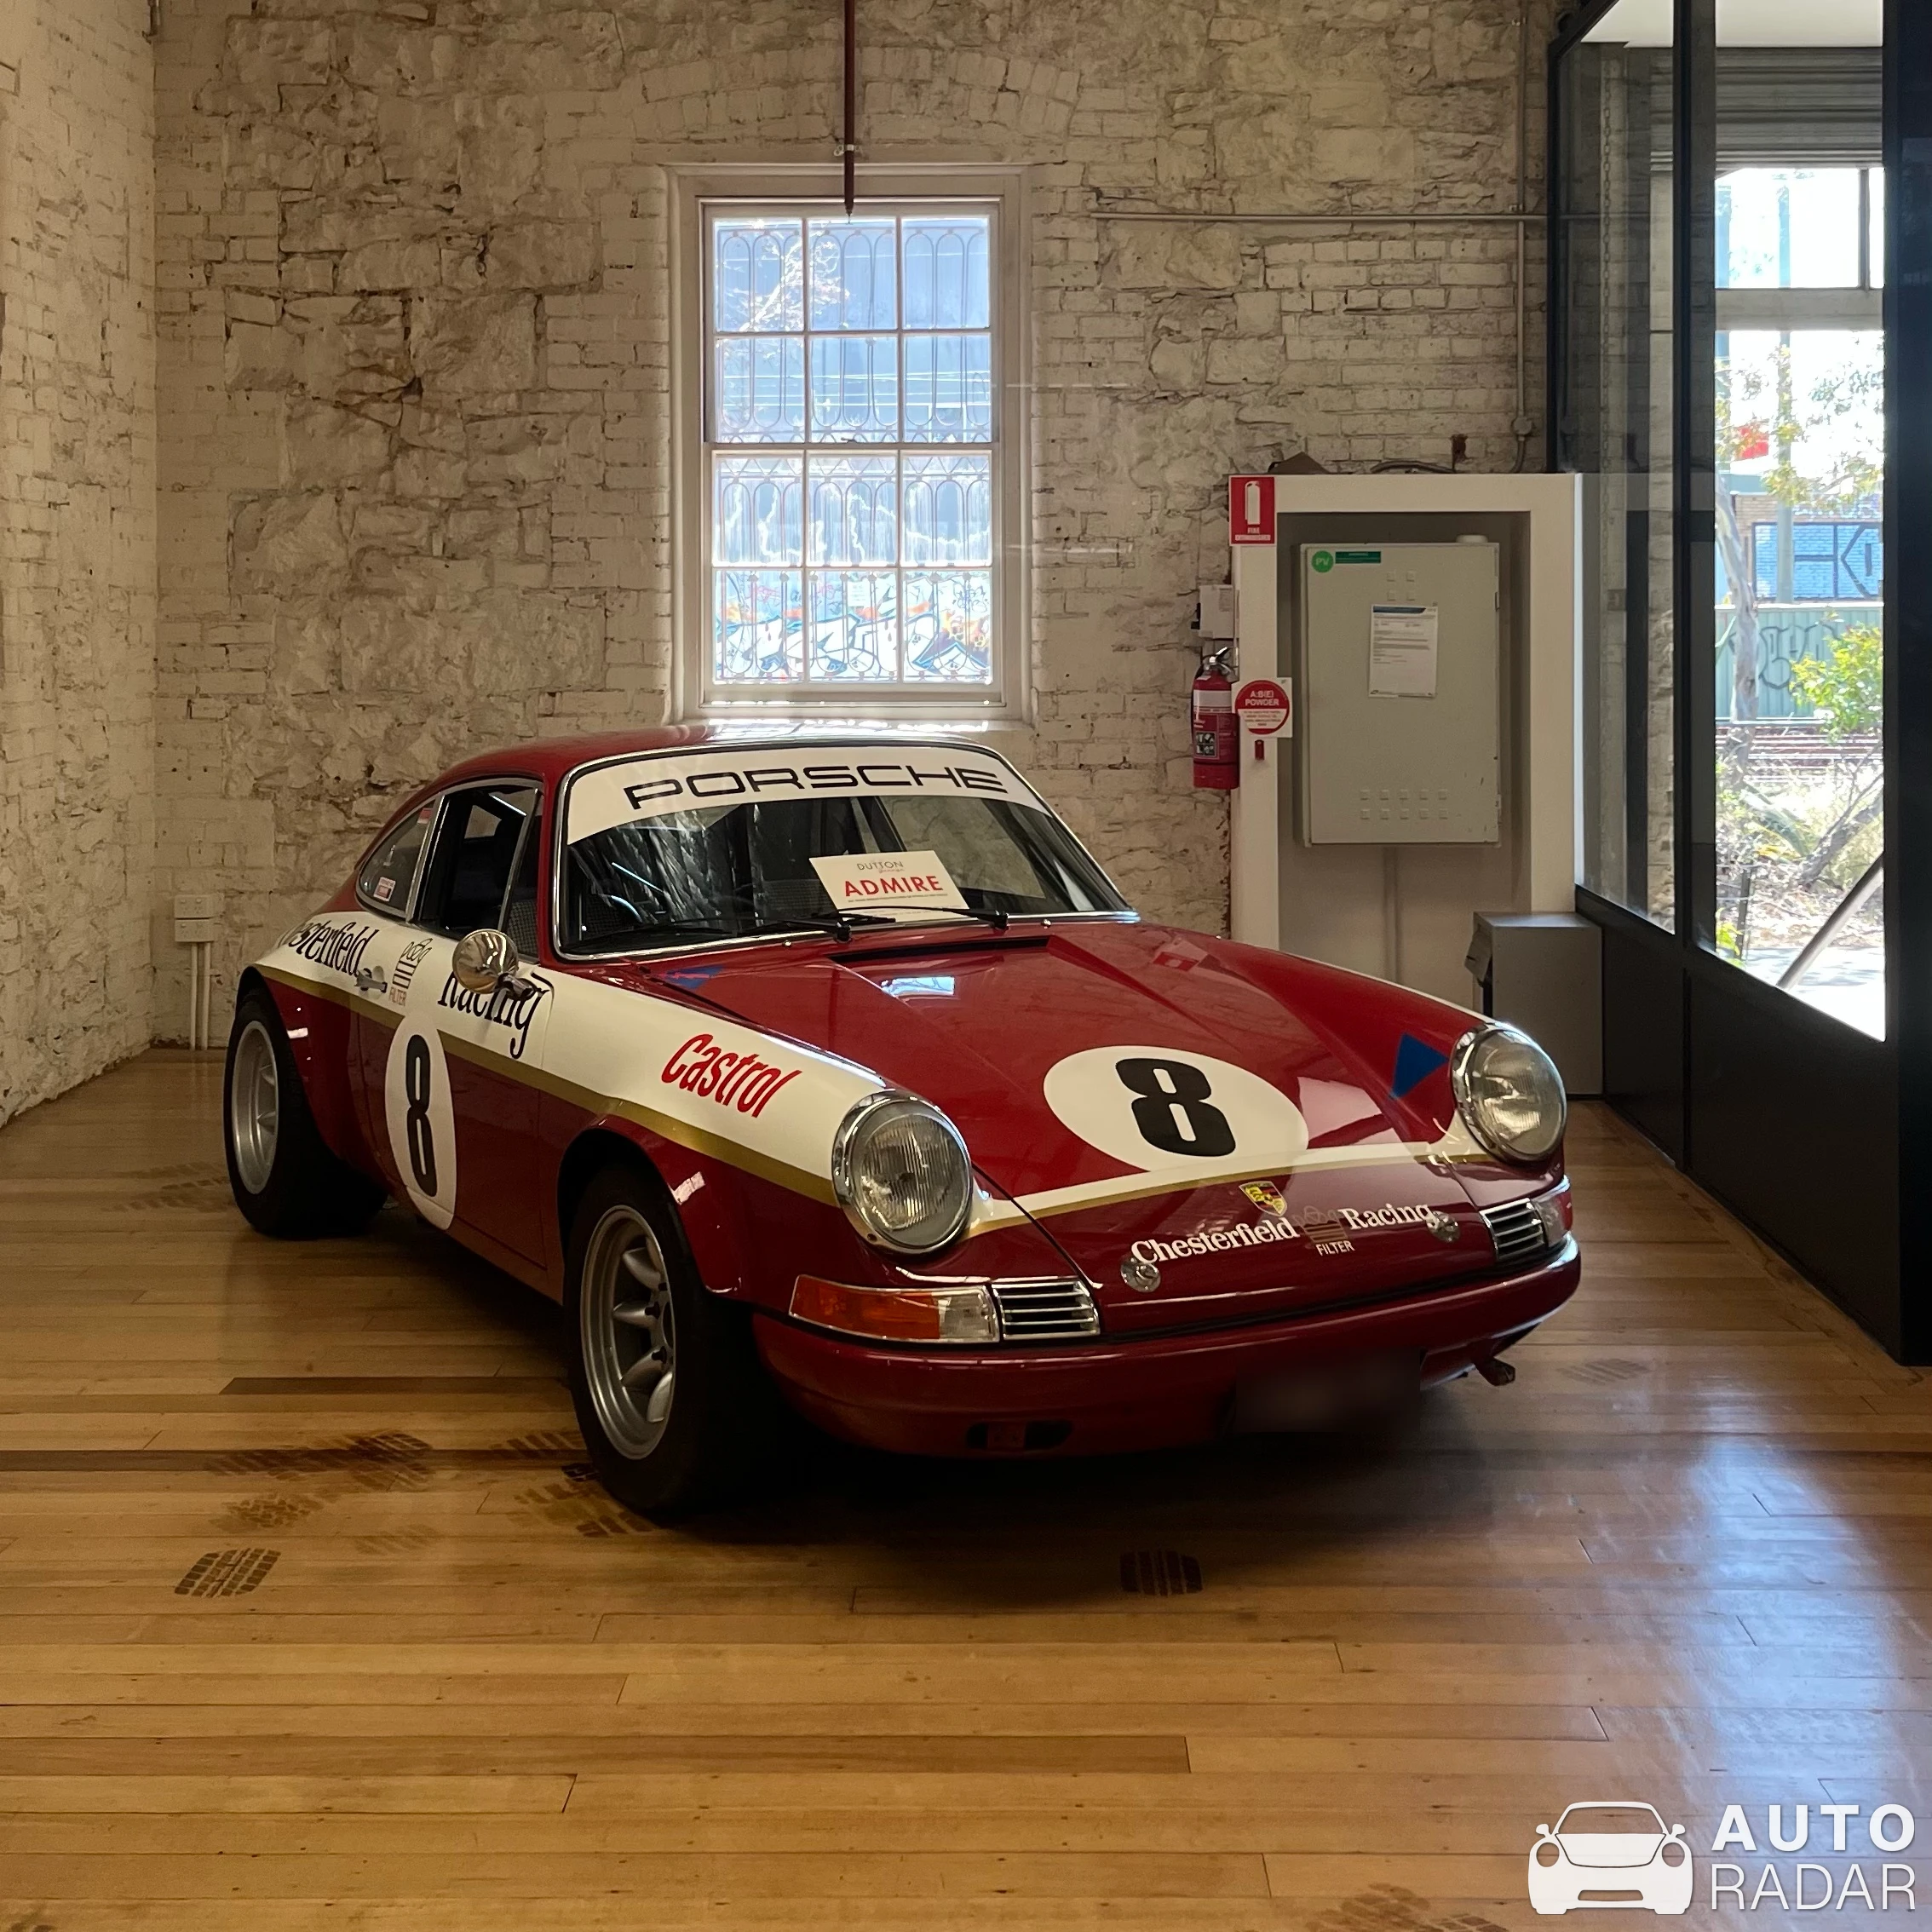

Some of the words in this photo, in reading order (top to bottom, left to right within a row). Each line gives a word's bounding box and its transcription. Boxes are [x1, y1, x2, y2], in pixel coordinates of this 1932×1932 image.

[1315, 557, 1330, 566] PV
[623, 765, 1008, 810] PORSCHE
[844, 876, 944, 897] ADMIRE
[856, 860, 904, 871] DUTTON
[661, 1033, 803, 1118] Castrol
[405, 1033, 438, 1198] 8
[1114, 1057, 1237, 1158] 8
[1131, 1216, 1301, 1265] Chesterfield
[1337, 1203, 1441, 1230] Racing
[1315, 1240, 1355, 1256] FILTER
